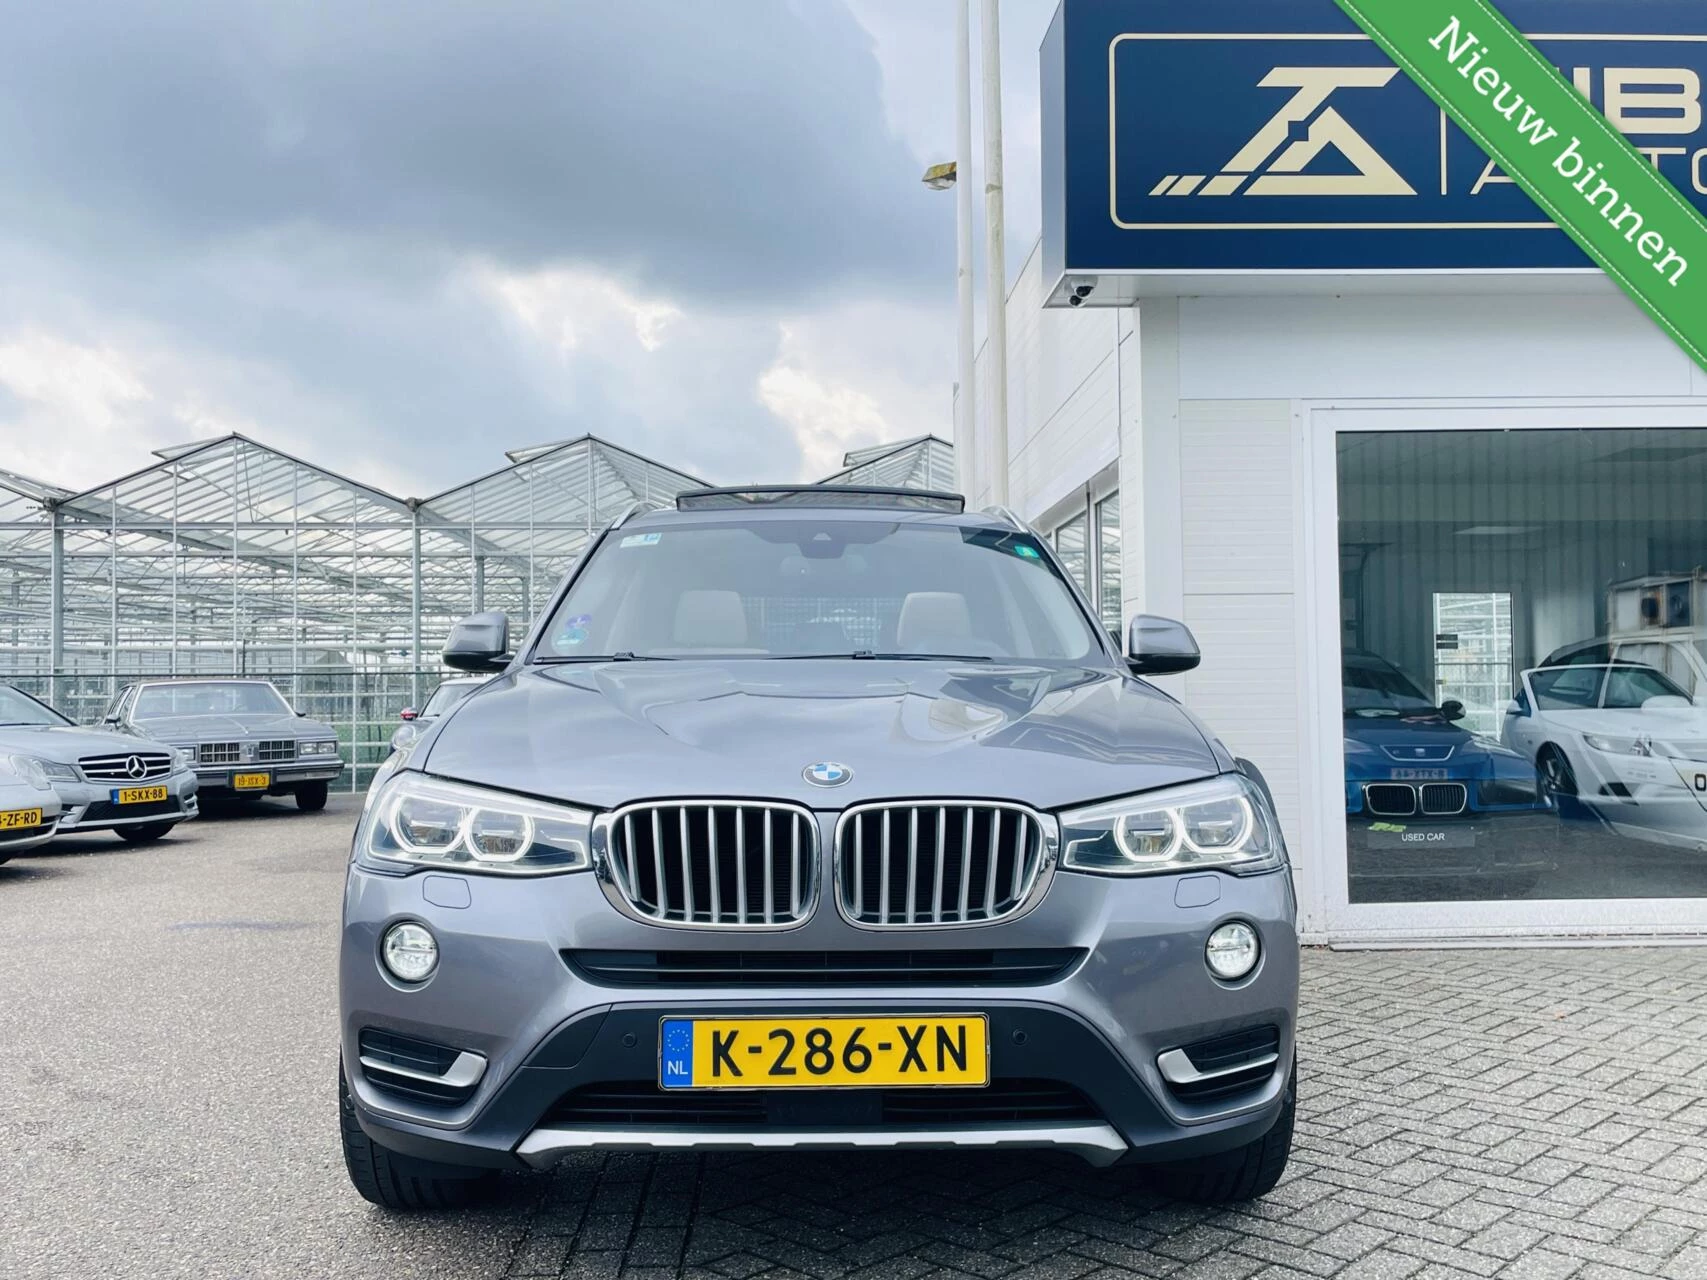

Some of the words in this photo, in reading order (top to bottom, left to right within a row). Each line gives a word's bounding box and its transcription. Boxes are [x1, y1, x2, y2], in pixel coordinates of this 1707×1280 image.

[123, 788, 163, 802] 1-SKX-88
[0, 811, 38, 827] -ZF-RD
[1401, 832, 1425, 842] USED
[1426, 832, 1446, 841] CAR
[667, 1060, 689, 1076] NL
[711, 1024, 968, 1078] K-286-XN
